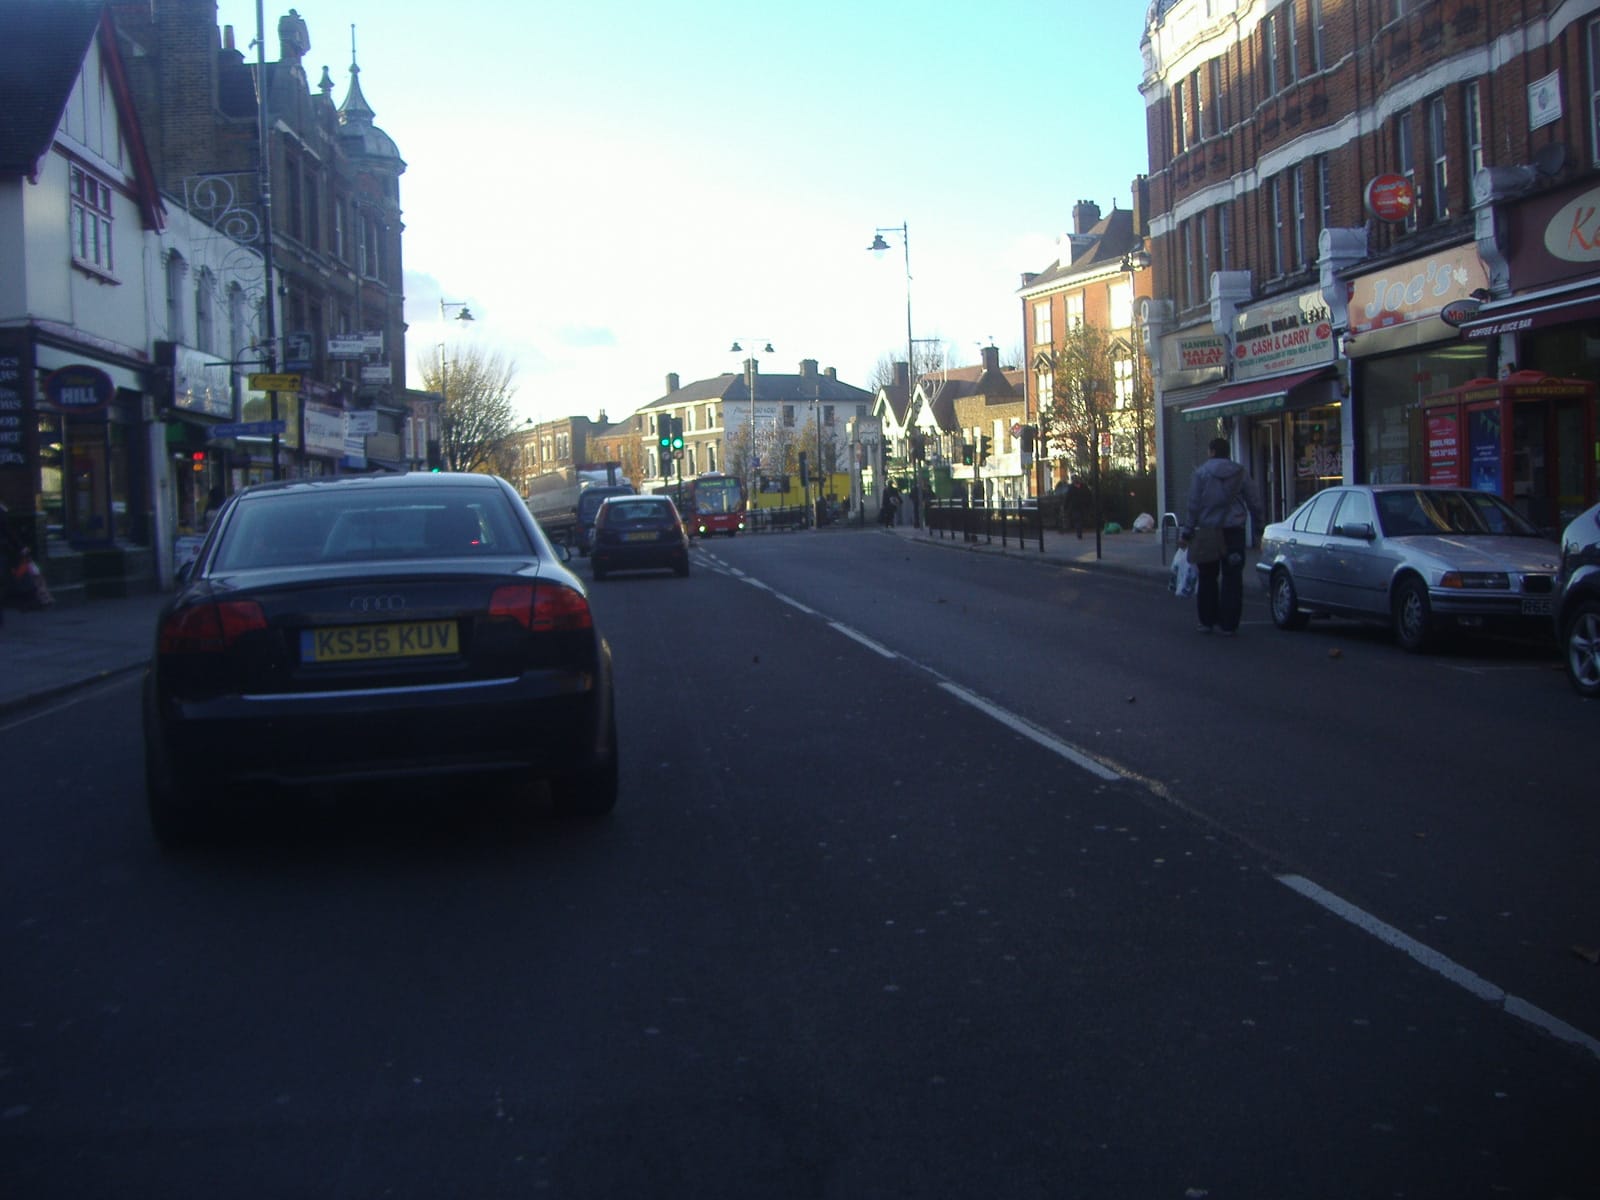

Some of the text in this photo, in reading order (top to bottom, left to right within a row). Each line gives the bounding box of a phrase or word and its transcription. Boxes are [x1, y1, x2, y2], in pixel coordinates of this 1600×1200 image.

[1365, 260, 1453, 318] Joe's
[1468, 318, 1533, 338] COFFEE & JUICE BAR
[1182, 338, 1223, 349] HANWELL
[1252, 328, 1310, 356] CASH & CARRY
[1183, 347, 1224, 358] HALAL
[1186, 357, 1221, 366] MEAT
[60, 387, 98, 404] HILL
[318, 624, 450, 656] KS56 KUV
